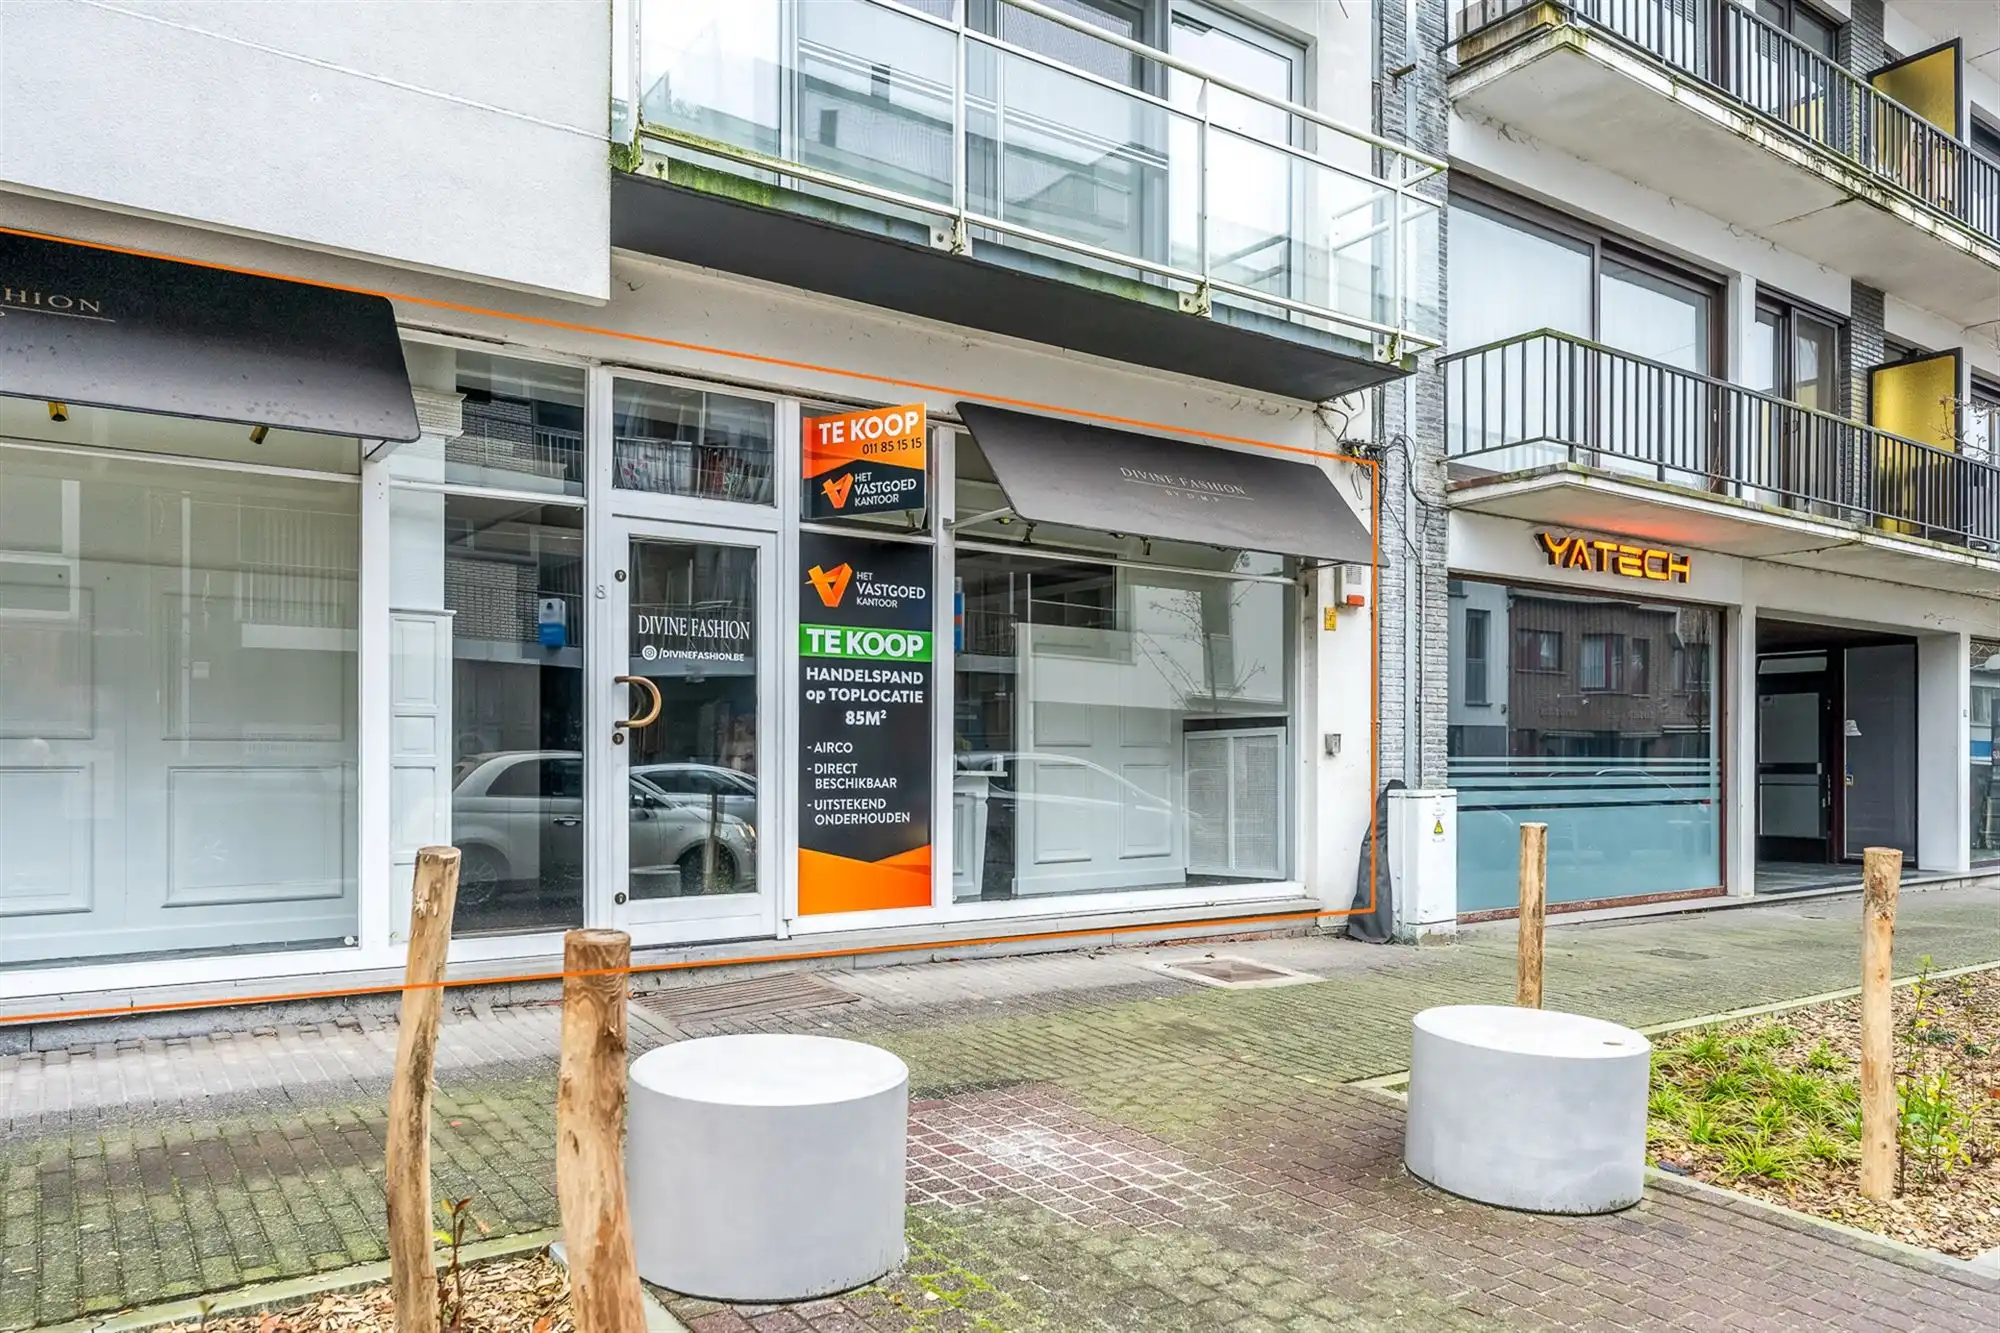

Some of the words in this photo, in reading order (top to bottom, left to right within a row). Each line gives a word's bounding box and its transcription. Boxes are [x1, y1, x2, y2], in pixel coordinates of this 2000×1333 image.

[818, 420, 845, 445] TE
[850, 411, 920, 442] KOOP
[862, 443, 878, 455] 011
[880, 440, 895, 453] 85
[897, 439, 908, 451] 15
[911, 436, 922, 449] 15
[854, 472, 872, 483] HET
[1119, 465, 1176, 486] DIVINE
[1178, 476, 1247, 496] FASHION
[854, 478, 917, 495] VASTGOED
[854, 494, 900, 507] KANTOOR
[1537, 531, 1692, 584] YATECH
[856, 571, 874, 581] HET
[856, 581, 926, 599] VASTGOED
[856, 597, 898, 608] KANTOOR
[638, 614, 688, 637] DIVINE
[691, 618, 750, 640] FASHION
[806, 627, 842, 654] TE
[846, 630, 924, 658] KOOP
[658, 648, 745, 662] /DIVINEFASHION.BE
[806, 666, 924, 684] HANDELSPAND
[805, 689, 826, 704] op
[828, 687, 924, 703] TOPLOCATIE
[813, 742, 853, 753] AIRCO
[814, 763, 858, 774] DIRECT
[815, 777, 897, 789] BESCHIKBAAR
[814, 798, 887, 810] UITSTEKEND
[814, 812, 910, 825] ONDERHOUDEN
